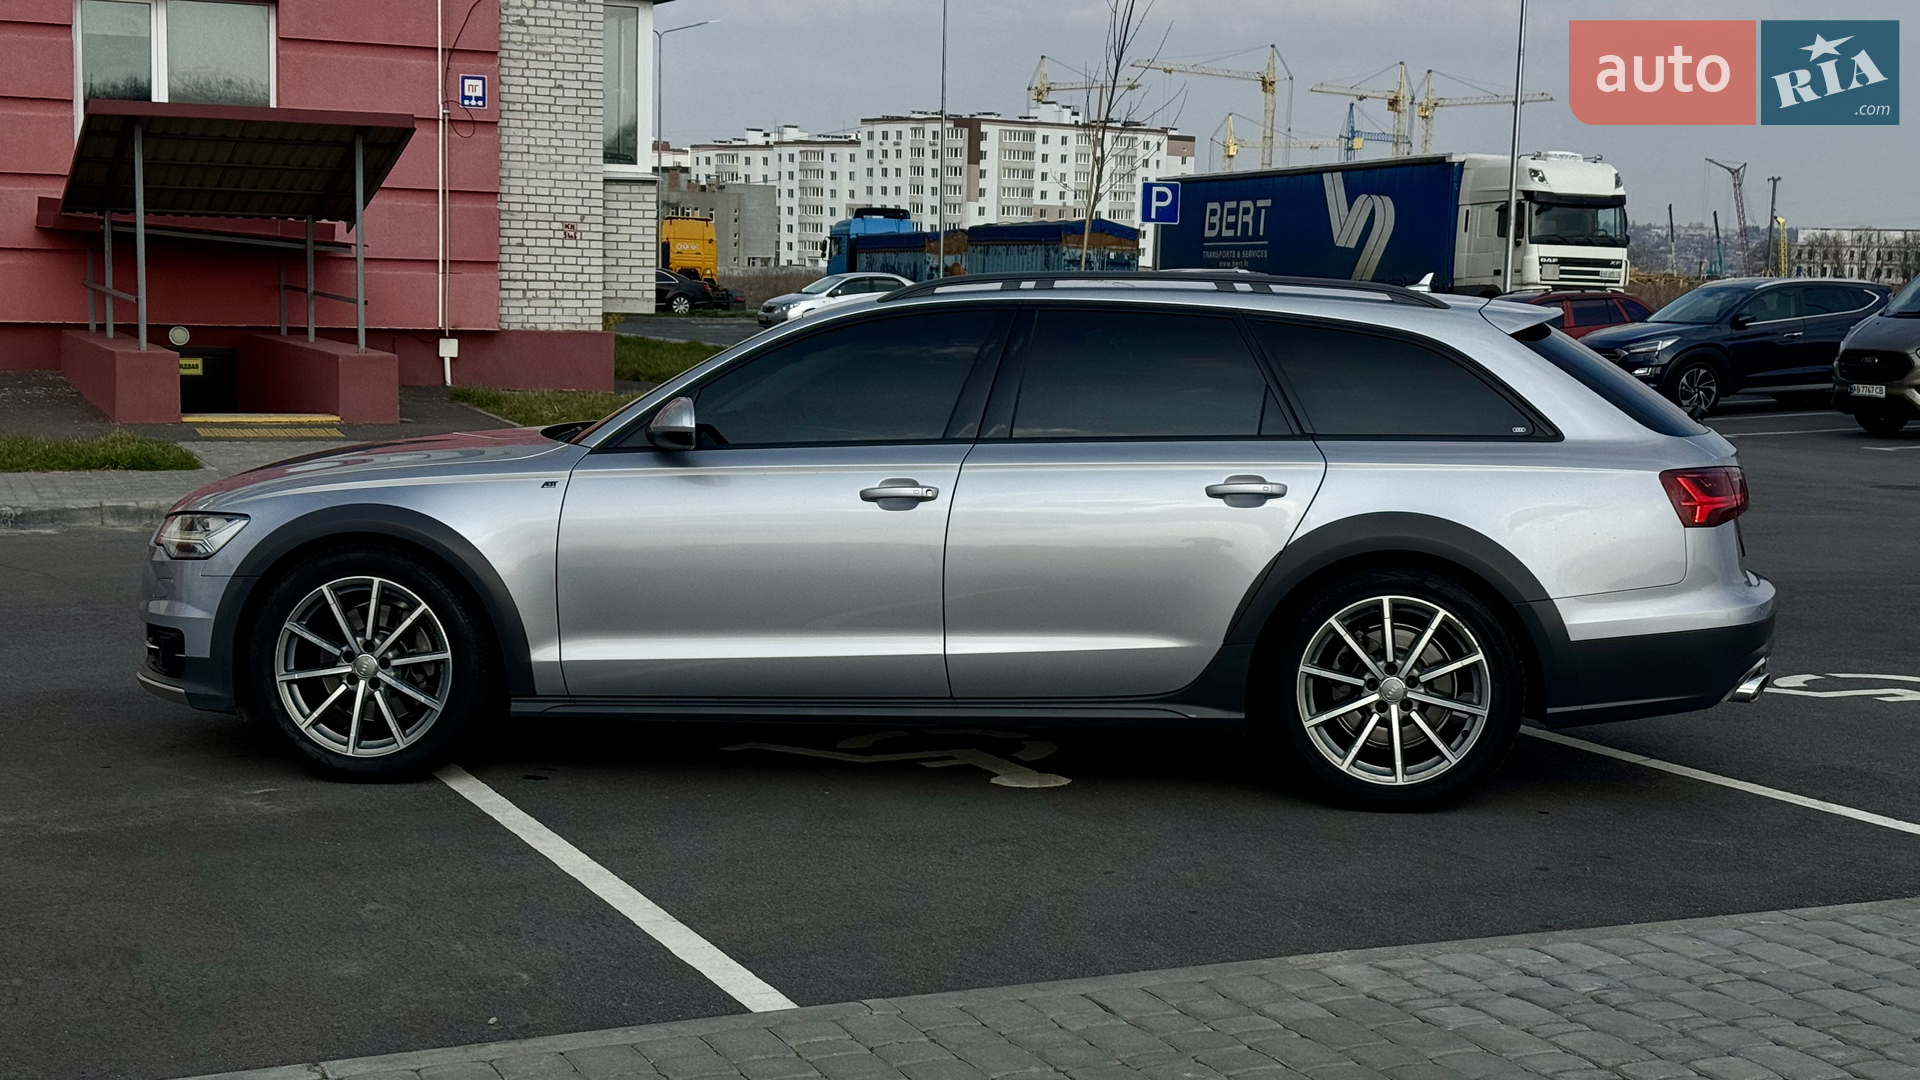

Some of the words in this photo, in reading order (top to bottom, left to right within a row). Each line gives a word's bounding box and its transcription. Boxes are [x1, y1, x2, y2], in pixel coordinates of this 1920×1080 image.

[1151, 186, 1173, 220] P
[1204, 199, 1272, 237] BERT
[1203, 250, 1236, 259] TRANSPORTS
[1242, 249, 1268, 258] SERVICES
